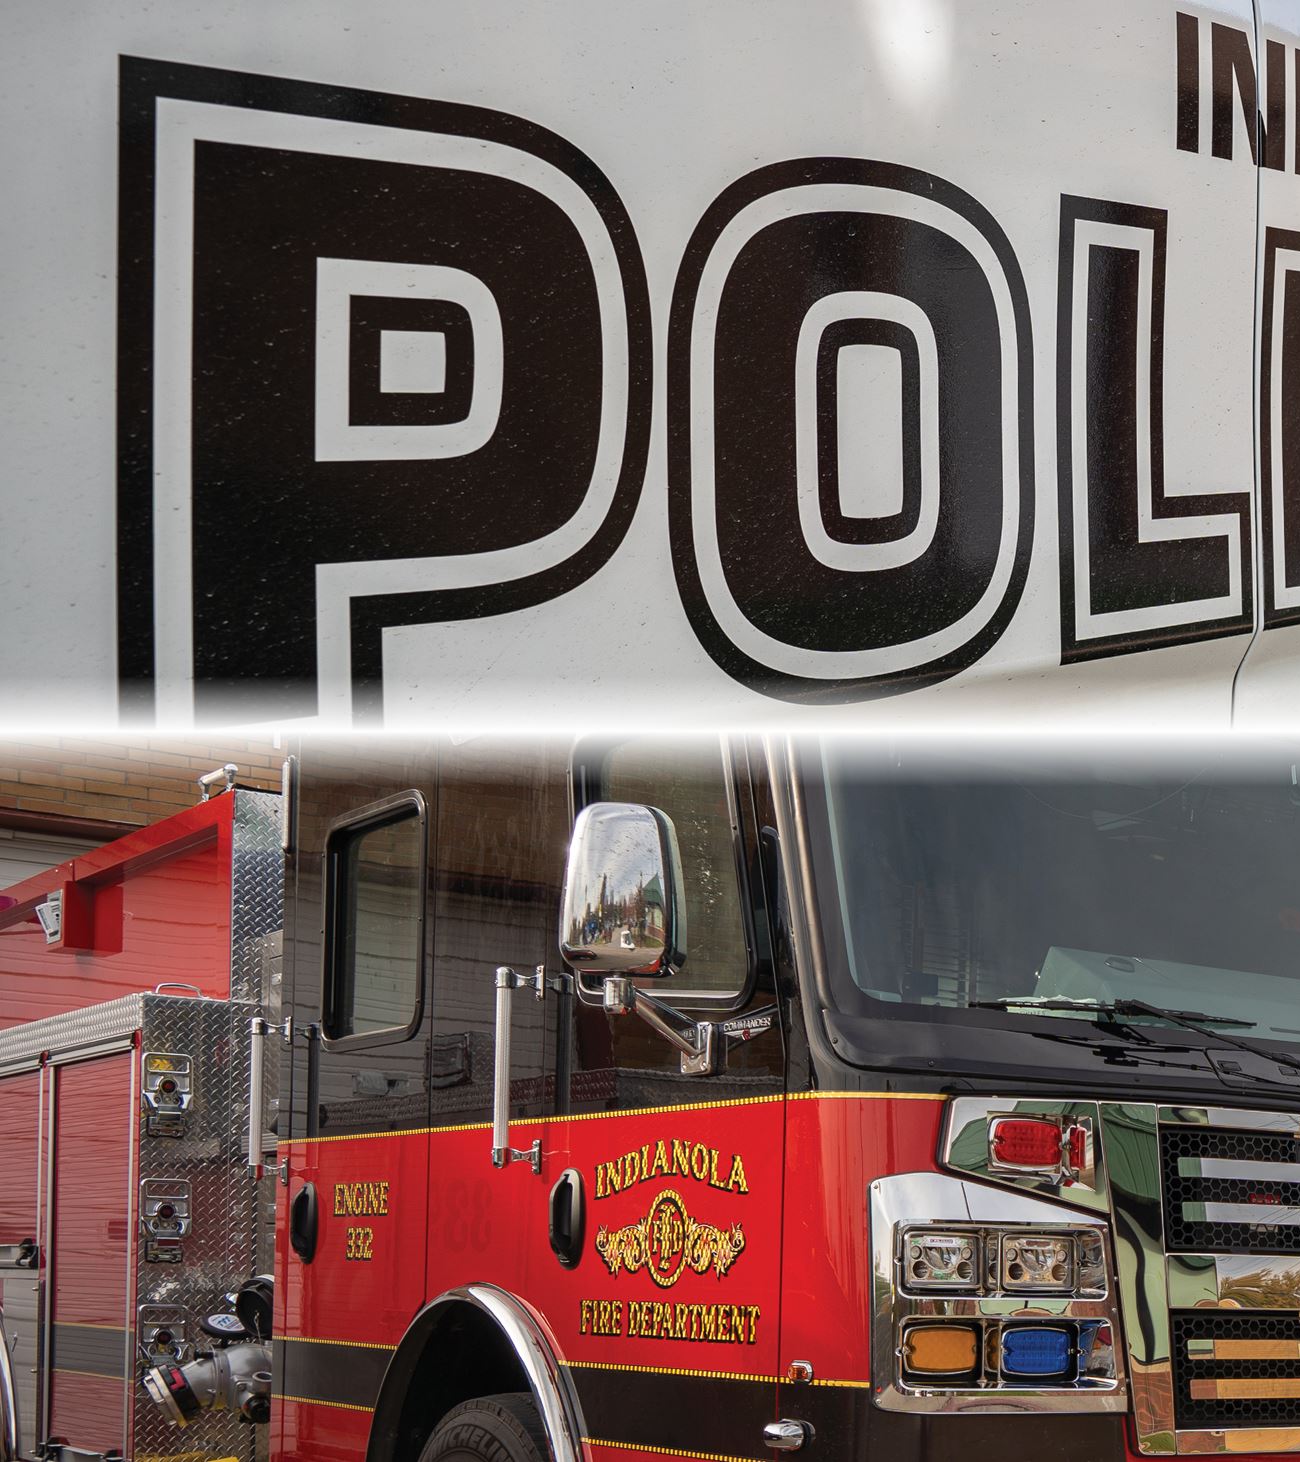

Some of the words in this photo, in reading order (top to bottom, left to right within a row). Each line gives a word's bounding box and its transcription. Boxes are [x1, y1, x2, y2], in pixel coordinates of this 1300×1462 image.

[723, 1016, 772, 1032] COMMANDER
[594, 1139, 749, 1200] INDIANOLA
[333, 1181, 389, 1217] ENGINE
[346, 1226, 373, 1261] 332
[579, 1299, 623, 1335] FIRE
[627, 1301, 761, 1345] DEPARTMENT
